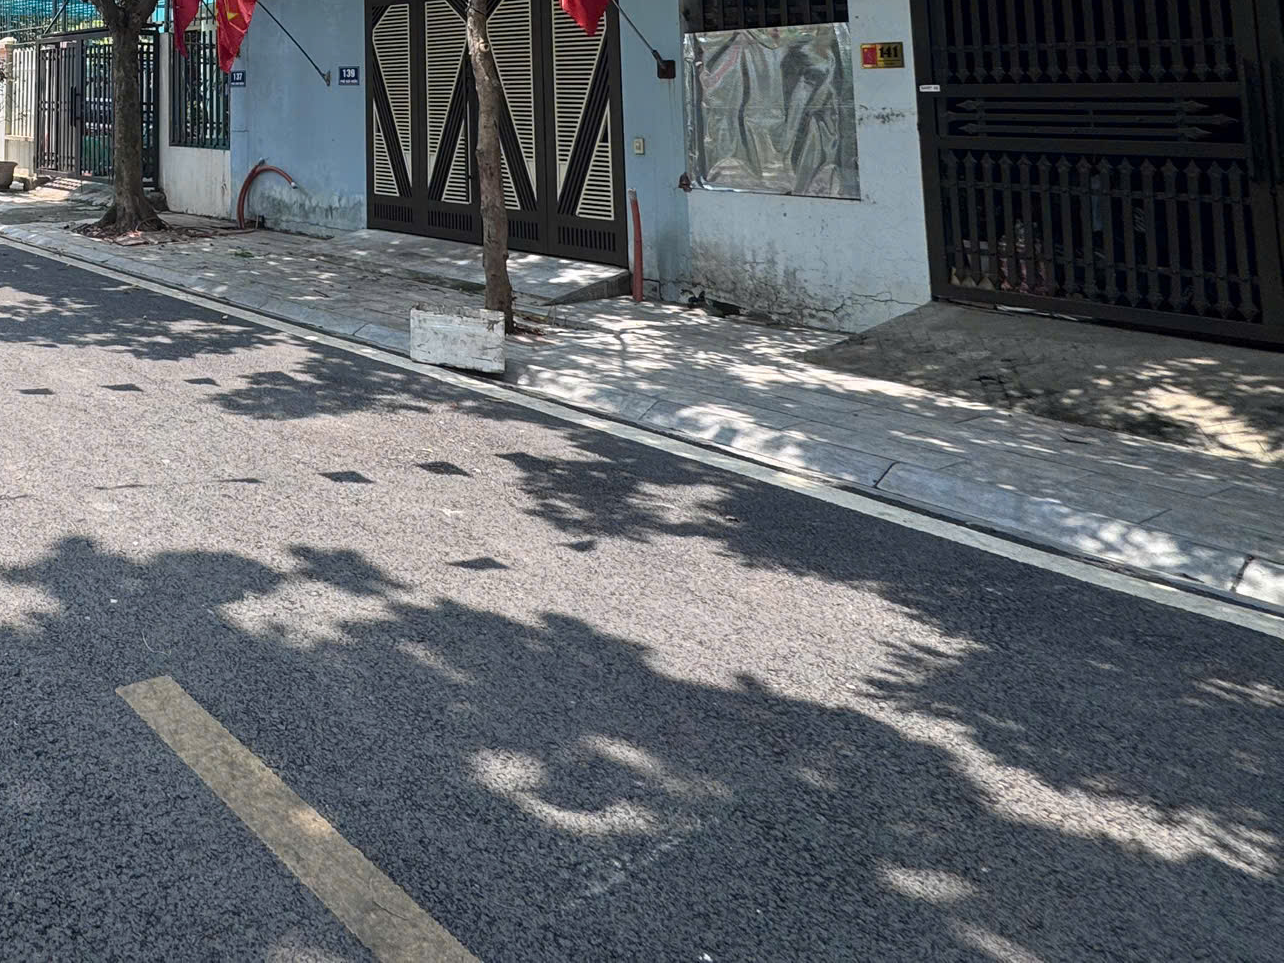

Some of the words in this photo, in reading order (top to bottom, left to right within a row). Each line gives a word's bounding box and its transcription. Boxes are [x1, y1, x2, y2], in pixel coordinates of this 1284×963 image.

[879, 46, 899, 58] 141
[233, 73, 242, 81] 137
[342, 69, 356, 78] 139
